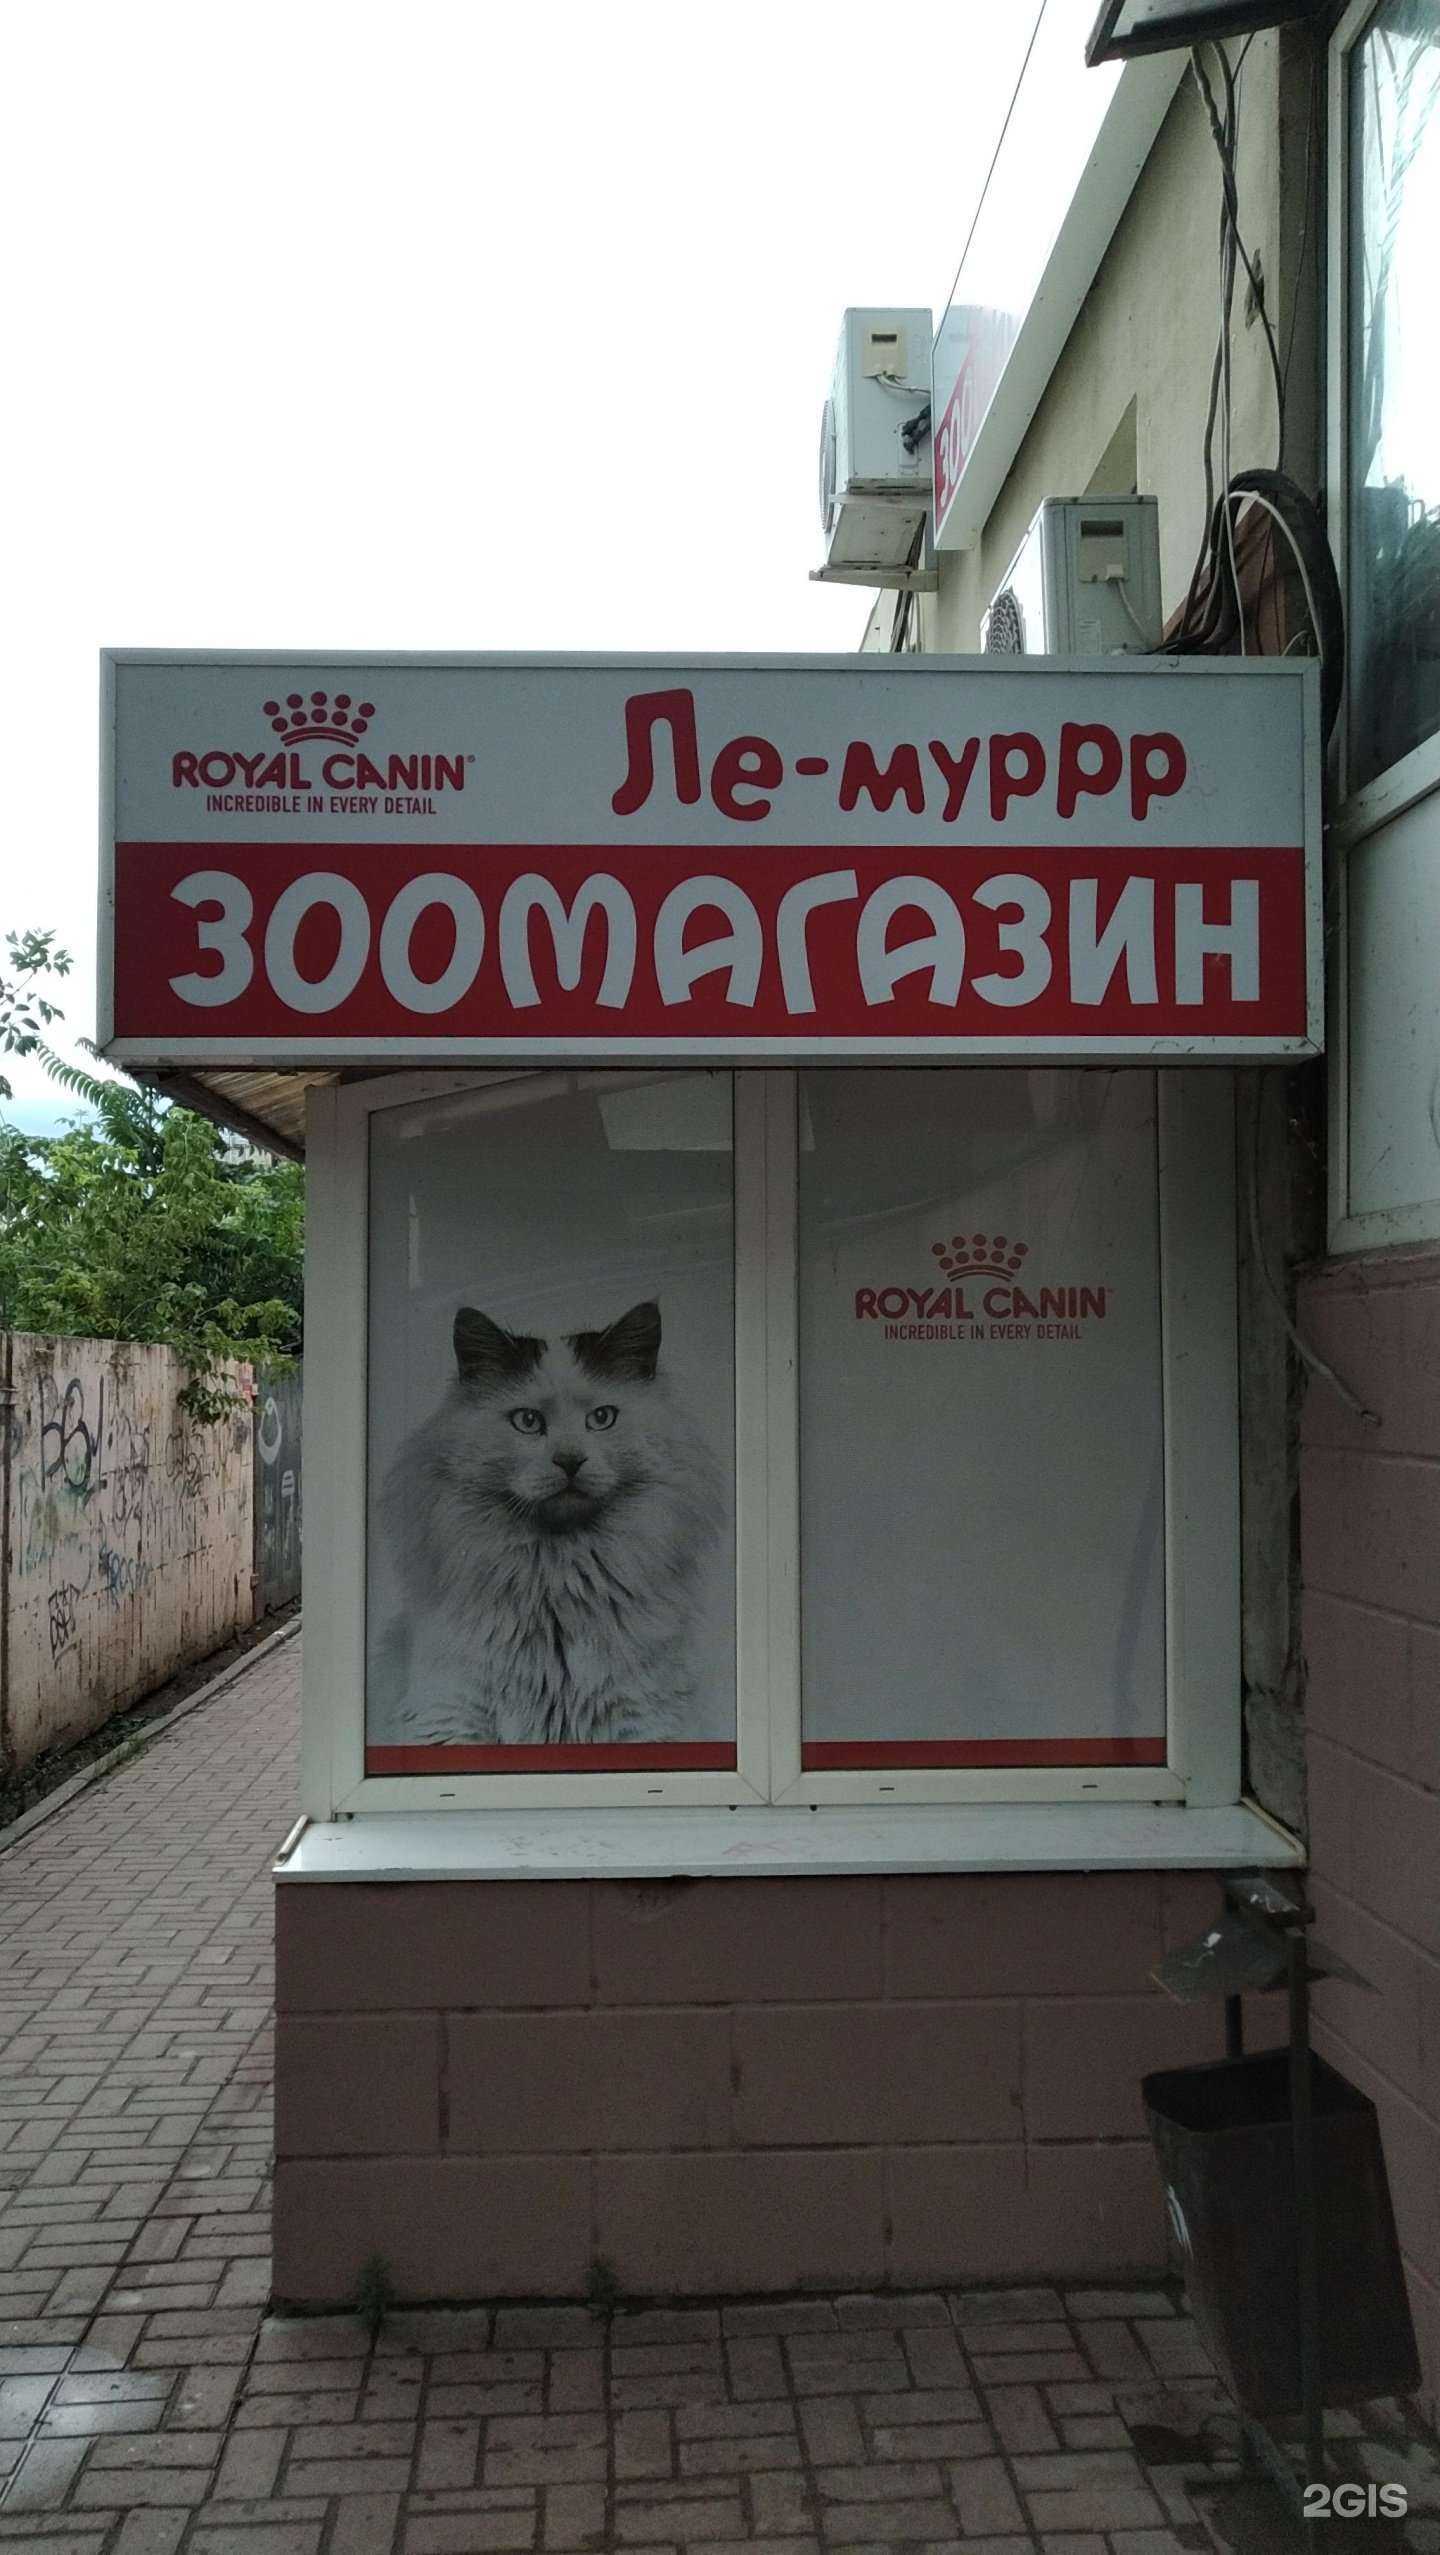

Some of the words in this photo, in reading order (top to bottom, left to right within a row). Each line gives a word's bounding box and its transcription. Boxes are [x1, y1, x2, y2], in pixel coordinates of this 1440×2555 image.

[172, 751, 311, 789] ROYAL
[613, 689, 1187, 823] Ле-муррр
[207, 795, 300, 813] INCREDIBLE
[307, 796, 323, 813] IN
[330, 797, 378, 814] EVERY
[384, 797, 437, 815] DETAIL
[168, 866, 1261, 1016] ЗООМАГАЗИН
[855, 1286, 974, 1320] ROYAL
[884, 1324, 965, 1341] INCREDIBLE
[970, 1324, 985, 1340] IN
[990, 1324, 1031, 1340] EVERY
[1037, 1323, 1081, 1340] DETAIL
